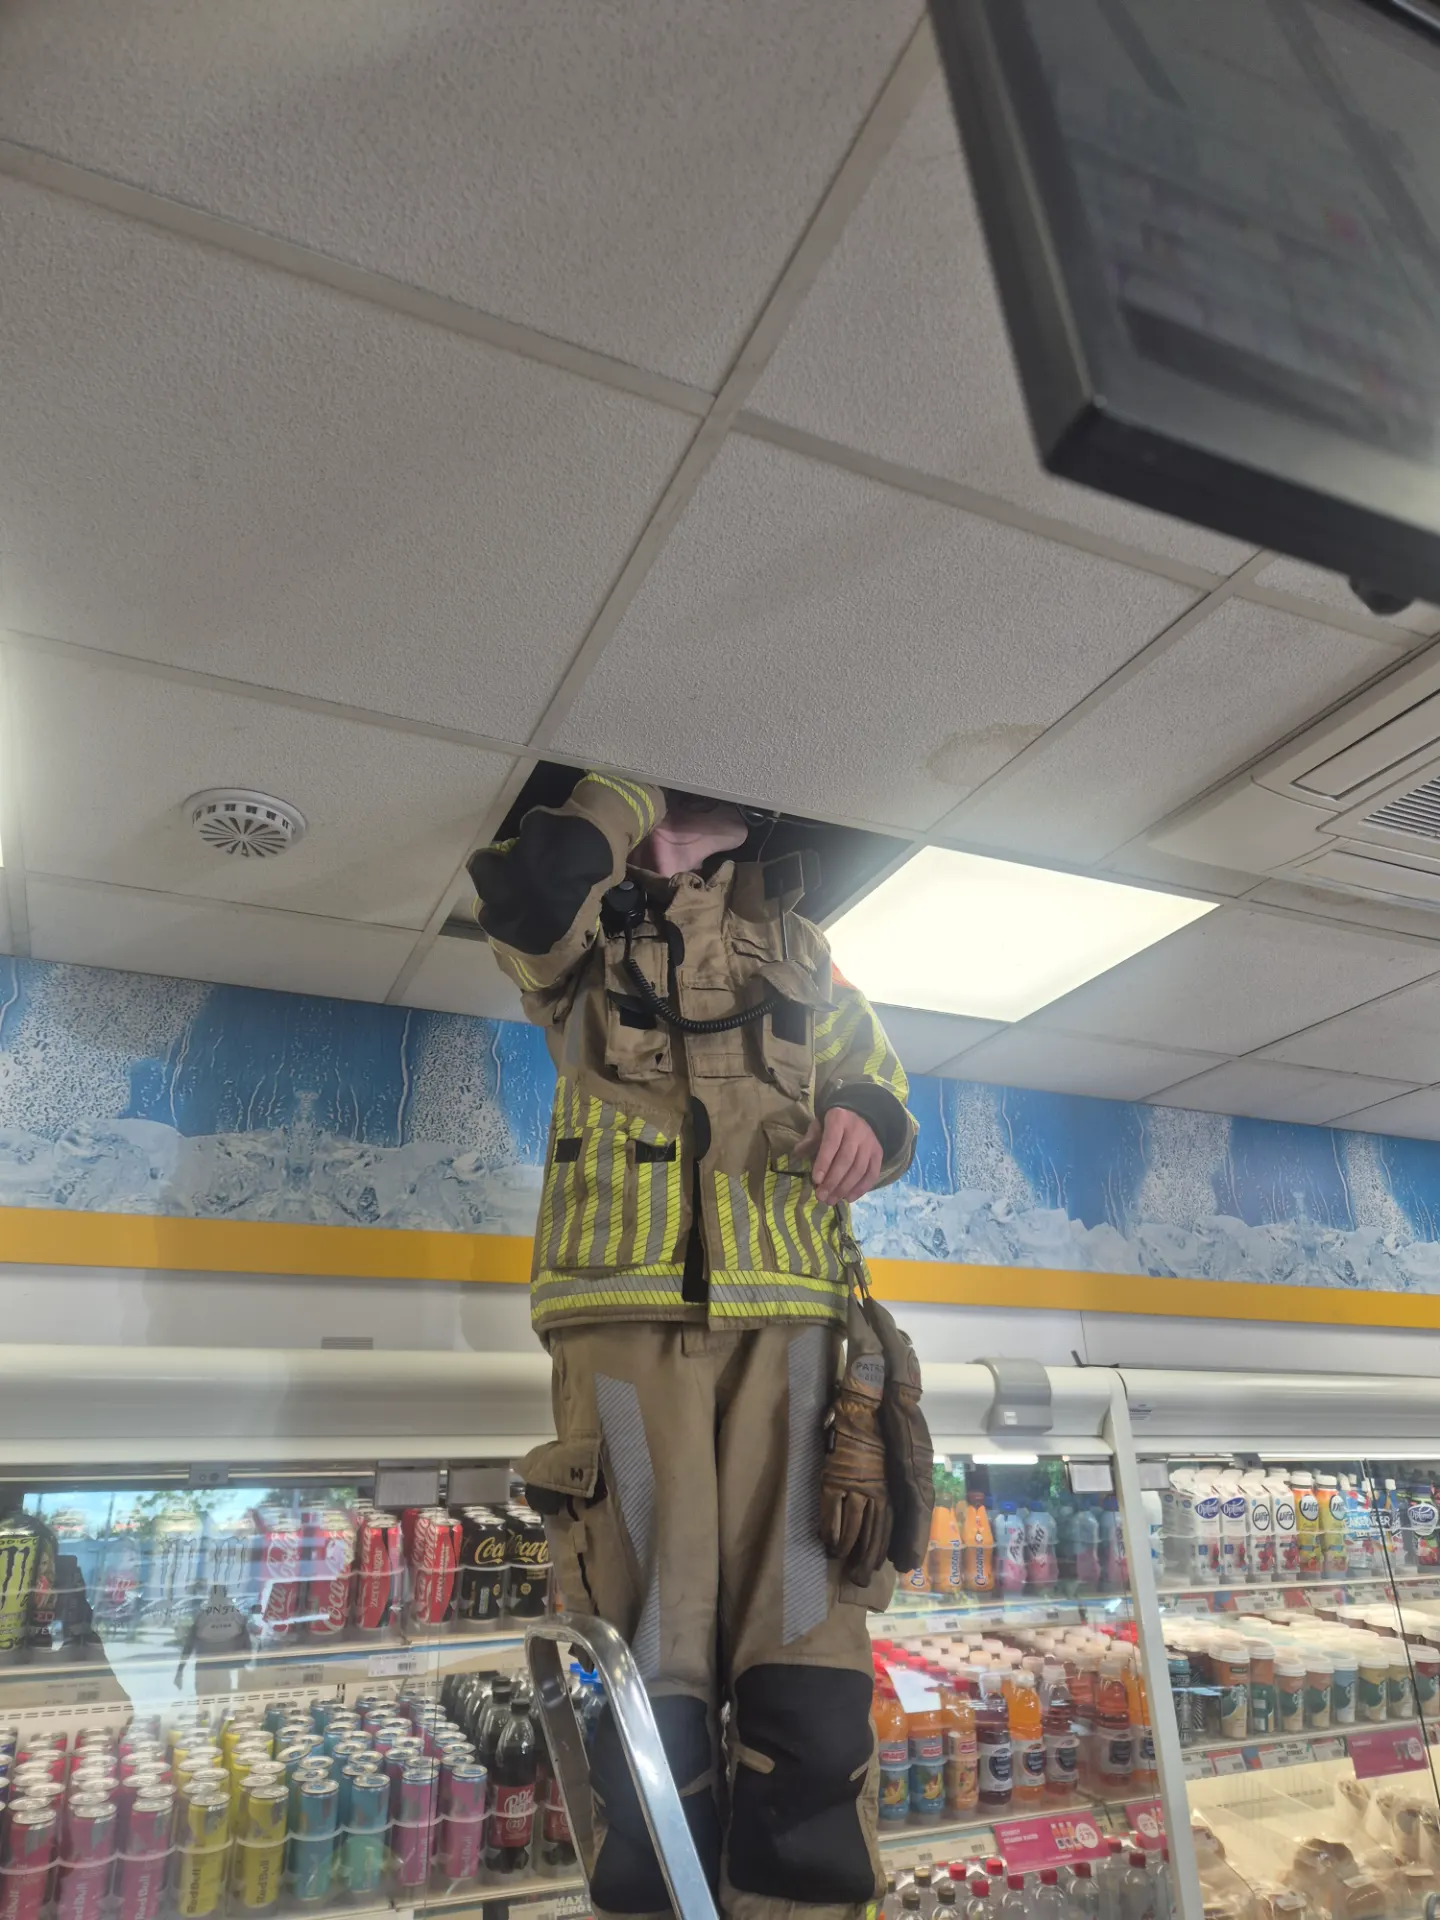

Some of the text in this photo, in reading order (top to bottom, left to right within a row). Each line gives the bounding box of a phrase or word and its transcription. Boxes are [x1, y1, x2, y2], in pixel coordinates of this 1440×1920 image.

[186, 1868, 201, 1914] Red Bull
[256, 1859, 270, 1904] Red Bull
